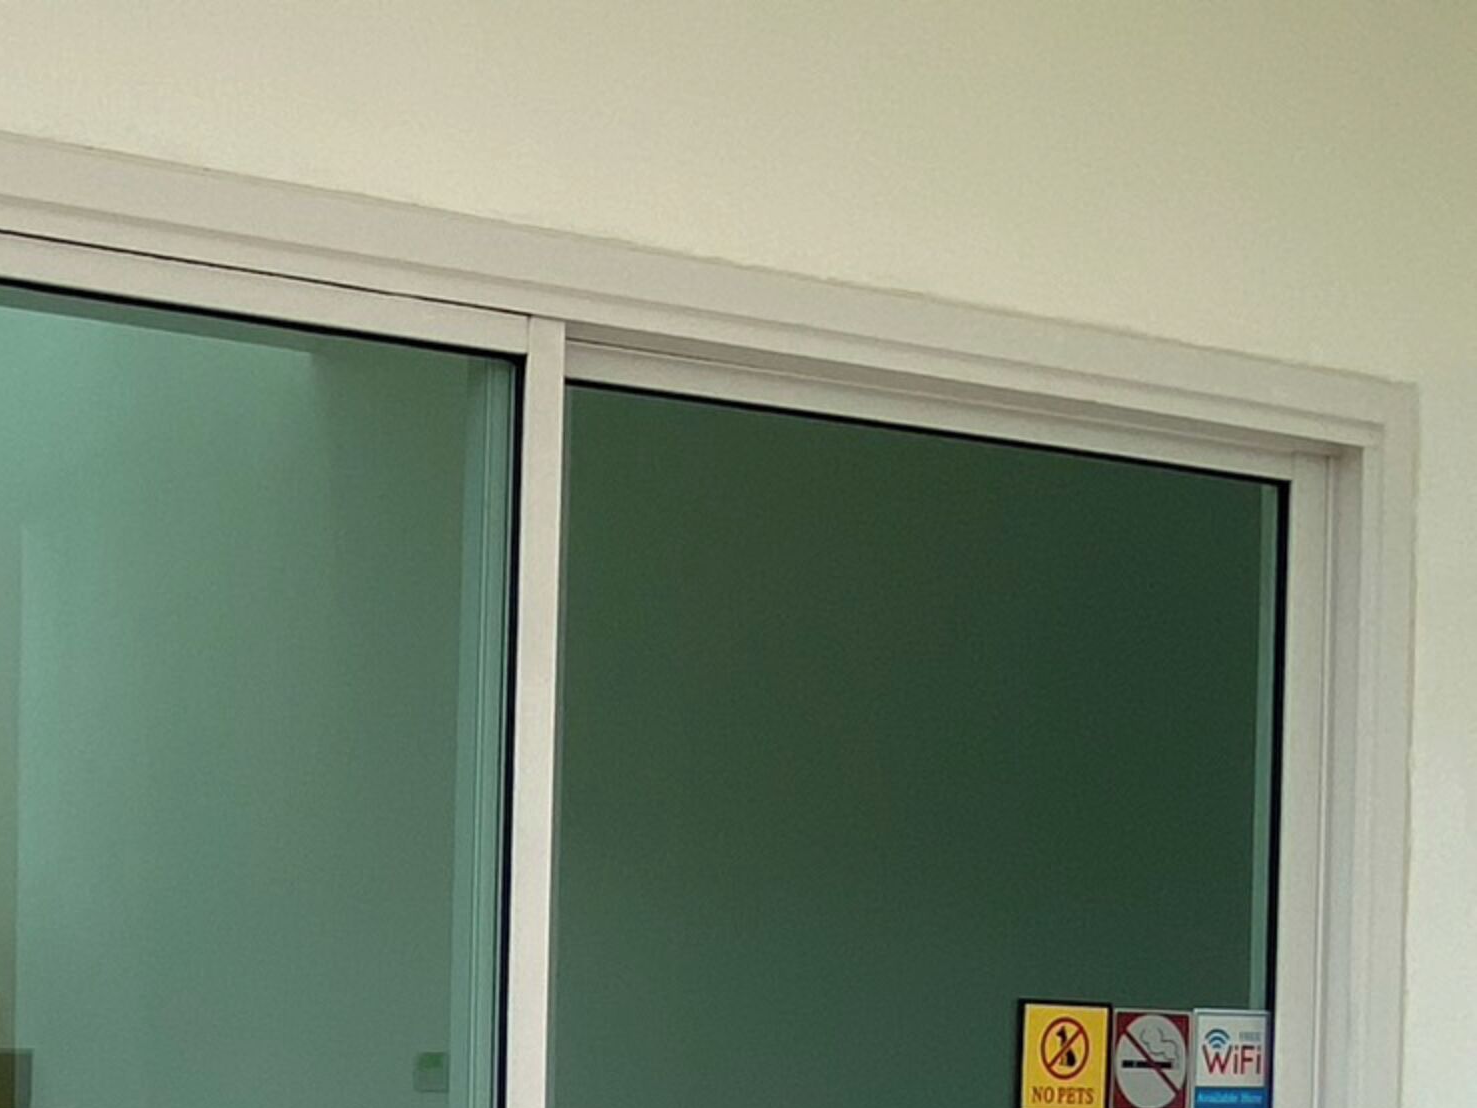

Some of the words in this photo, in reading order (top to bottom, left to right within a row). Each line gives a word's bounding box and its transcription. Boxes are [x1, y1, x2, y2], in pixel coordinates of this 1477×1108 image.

[1202, 1044, 1261, 1075] WiFi
[1032, 1087, 1052, 1104] NO
[1058, 1087, 1094, 1105] PETS
